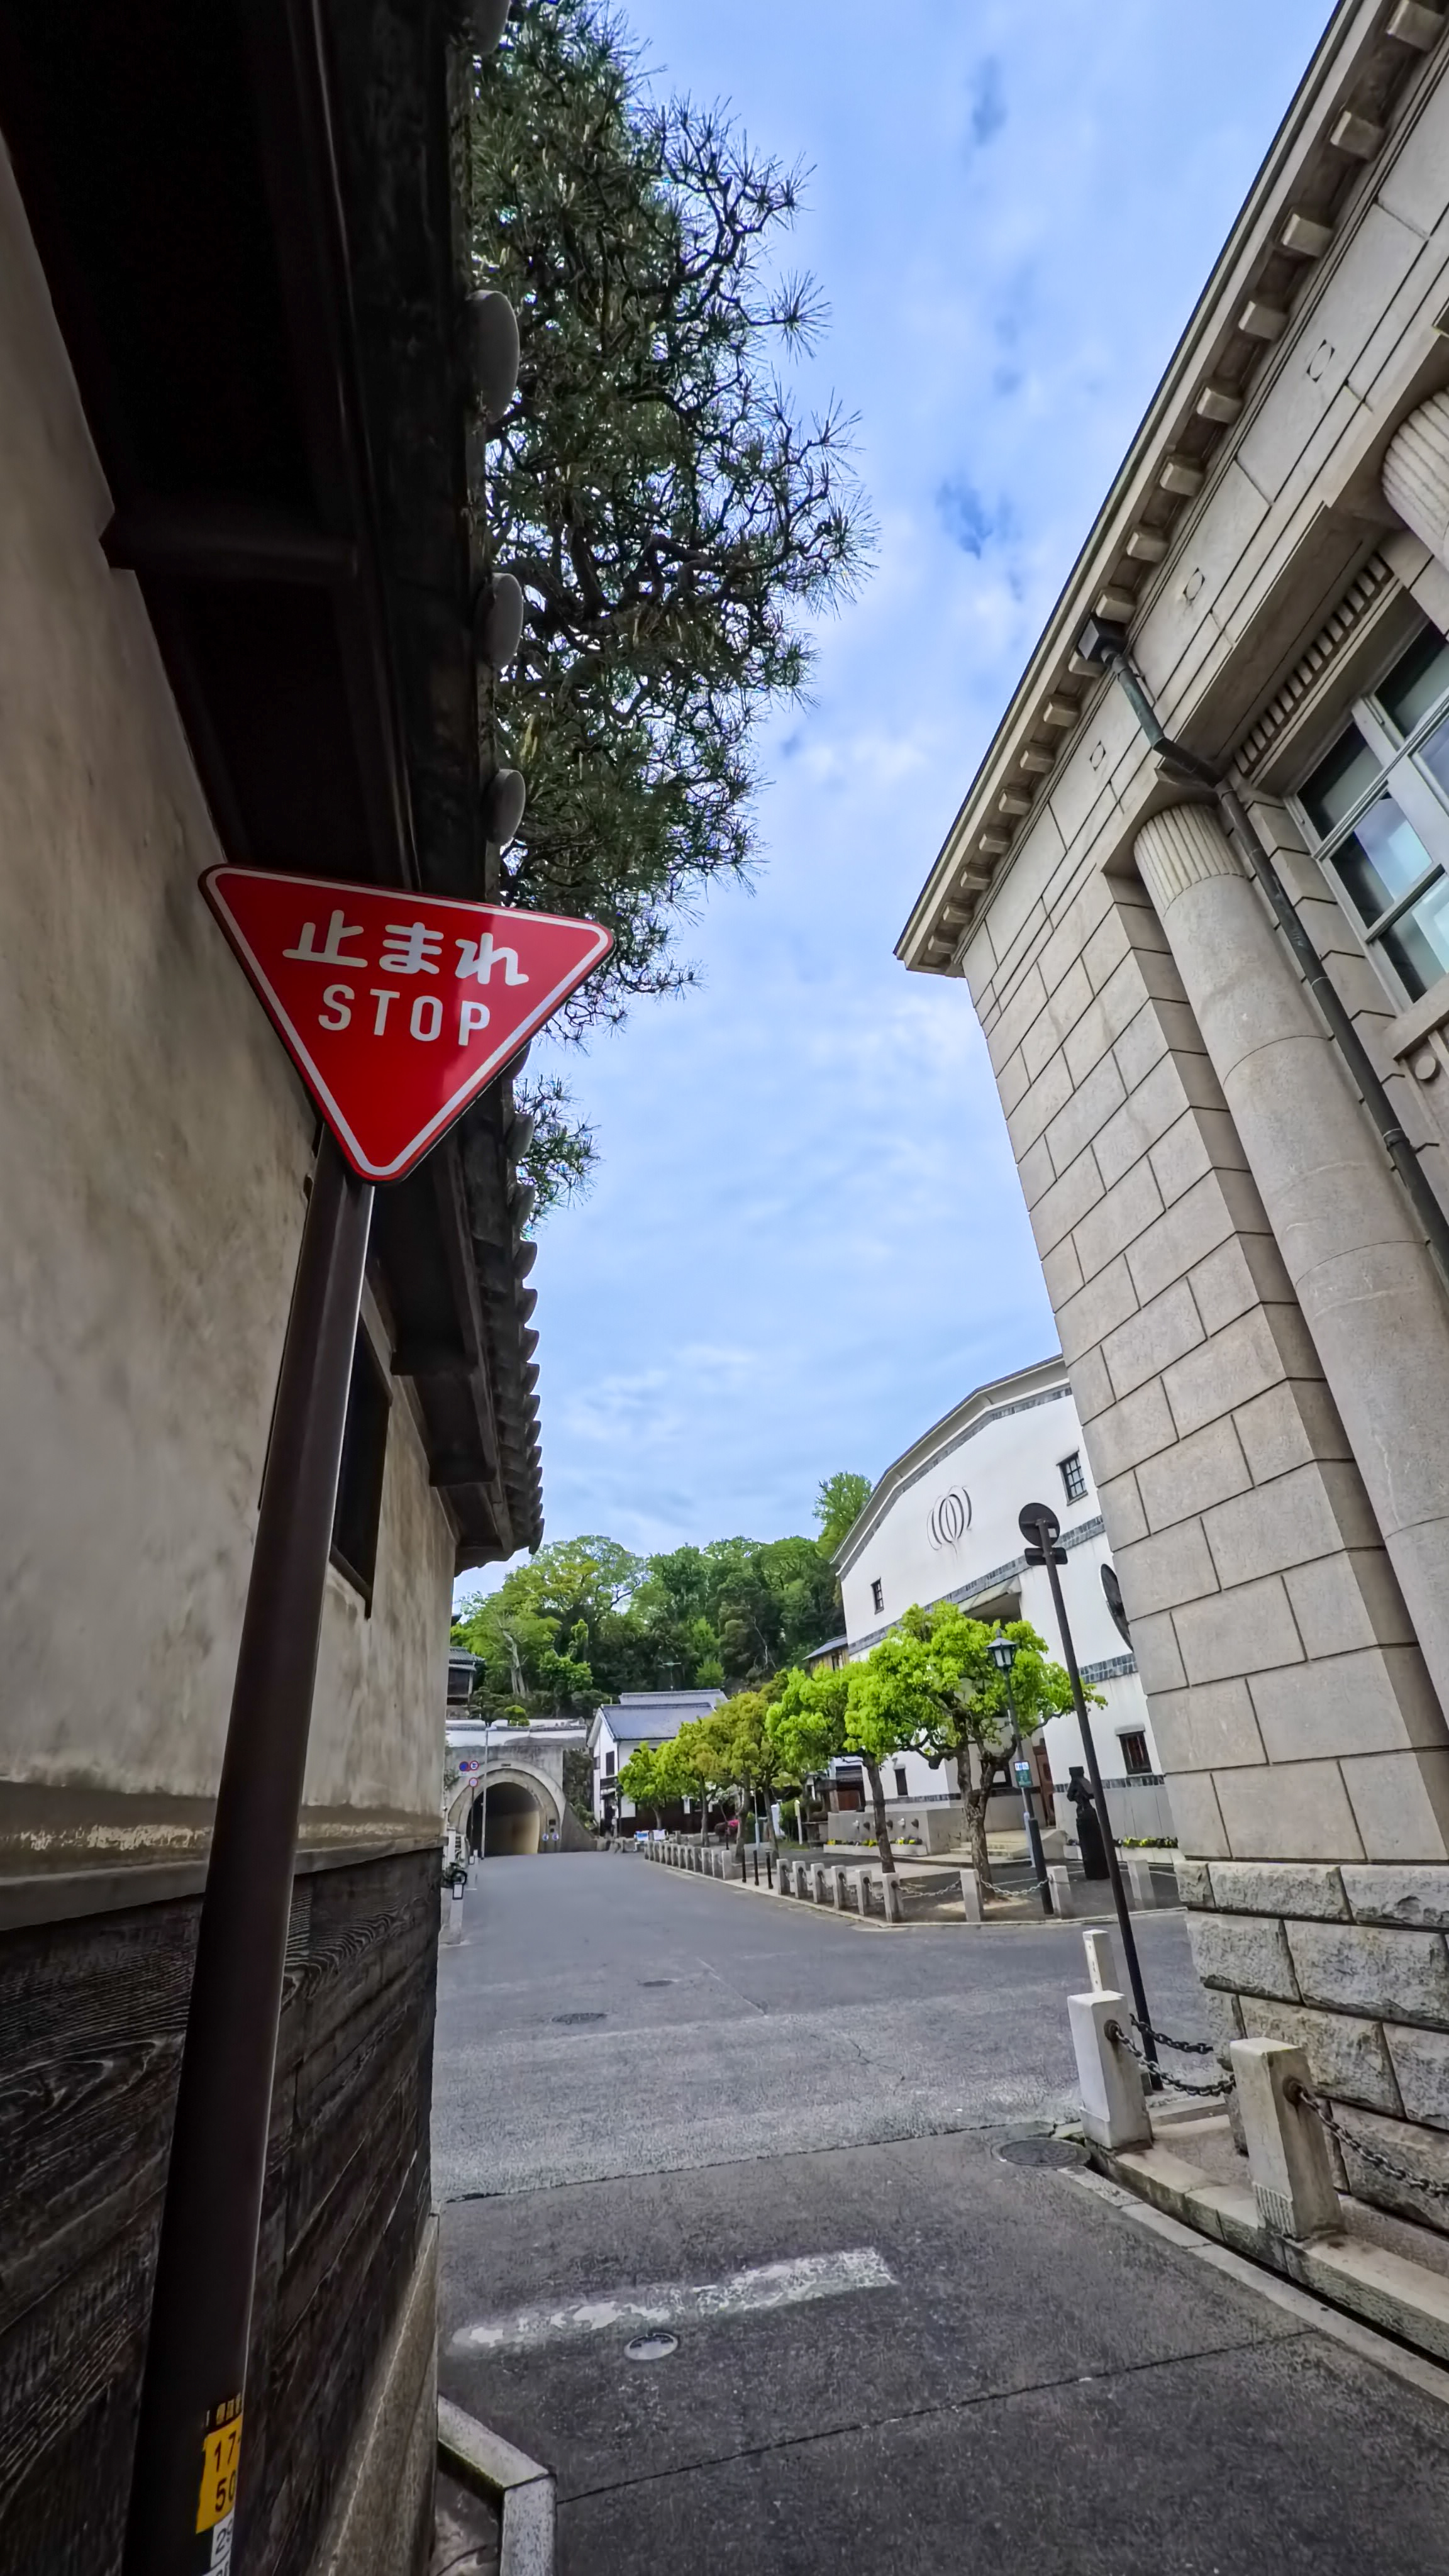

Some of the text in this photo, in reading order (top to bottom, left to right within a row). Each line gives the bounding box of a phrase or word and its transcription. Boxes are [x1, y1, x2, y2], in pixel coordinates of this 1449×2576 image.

[282, 910, 529, 986] 止まれ
[318, 984, 491, 1046] STOP
